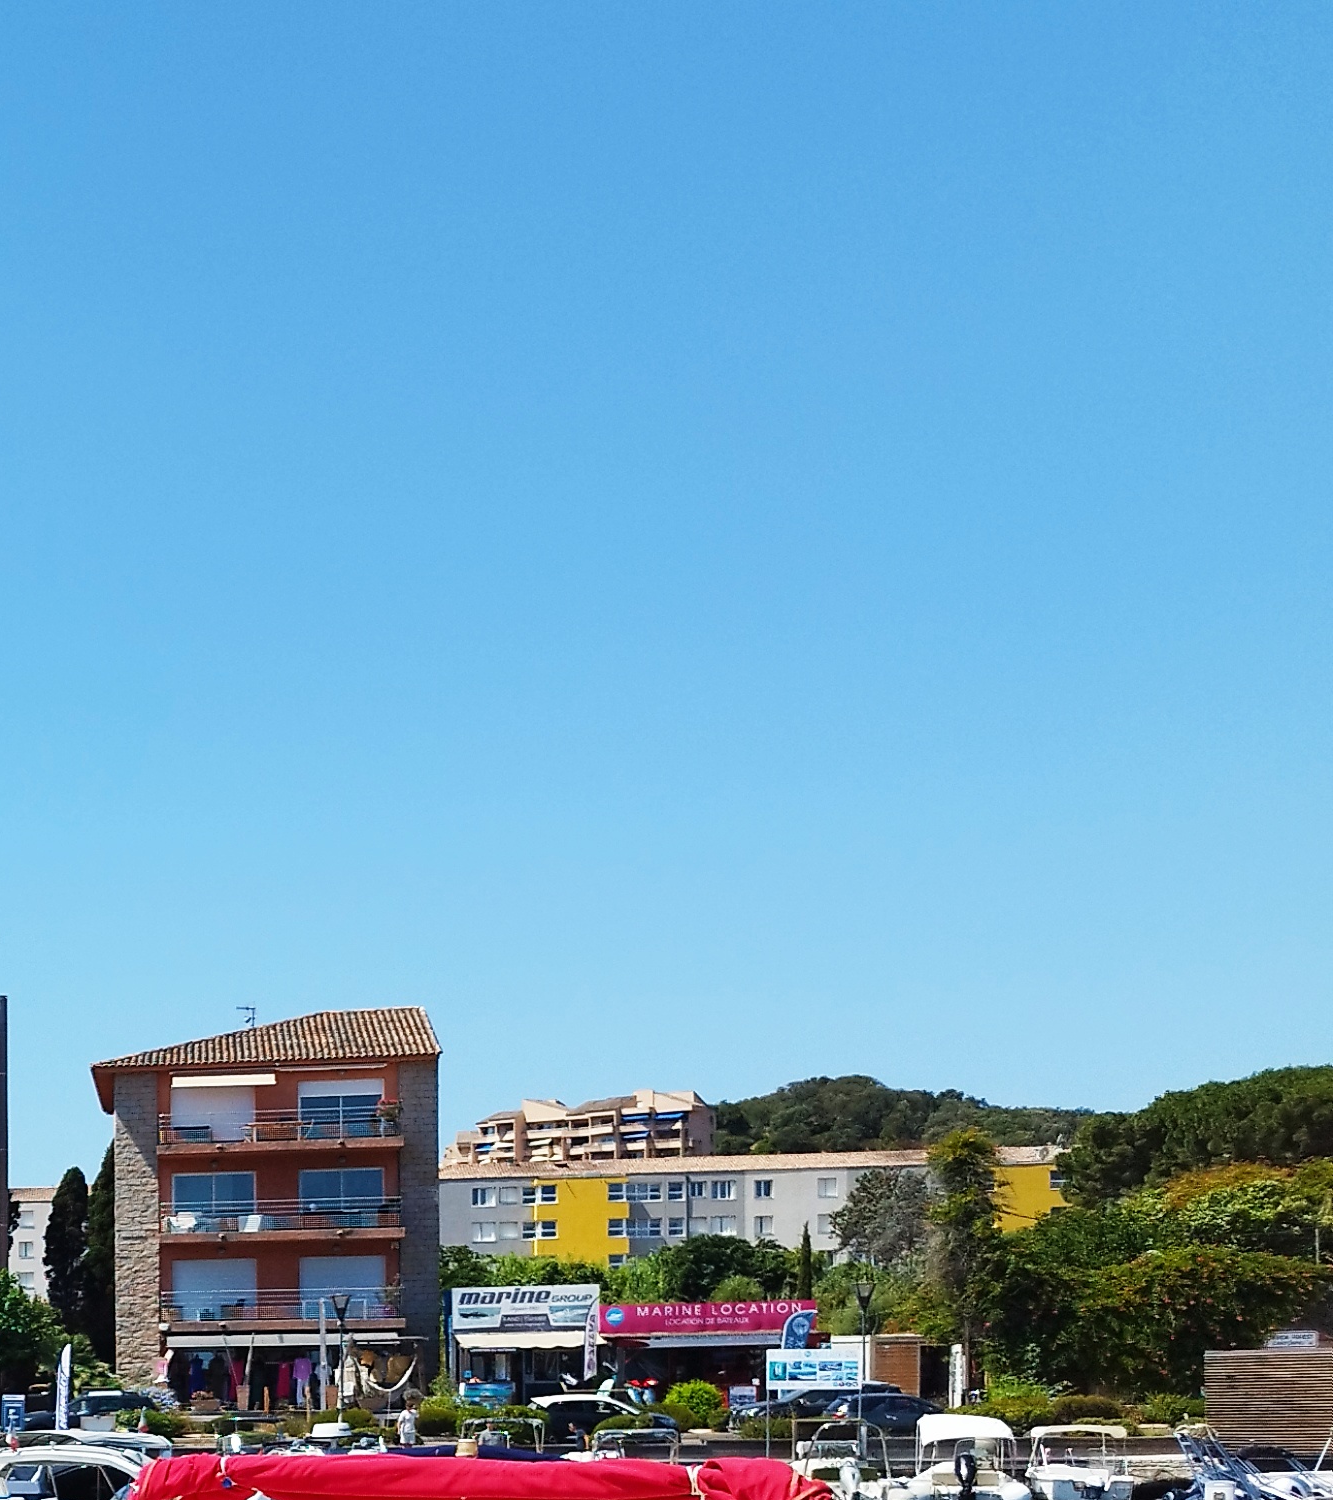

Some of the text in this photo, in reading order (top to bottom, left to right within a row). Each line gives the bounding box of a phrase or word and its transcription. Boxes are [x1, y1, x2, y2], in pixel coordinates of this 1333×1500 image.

[458, 1288, 593, 1305] marine GROUP
[636, 1302, 803, 1317] MARINE LOCATION
[665, 1316, 750, 1326] LOCATION DE BATEAUX
